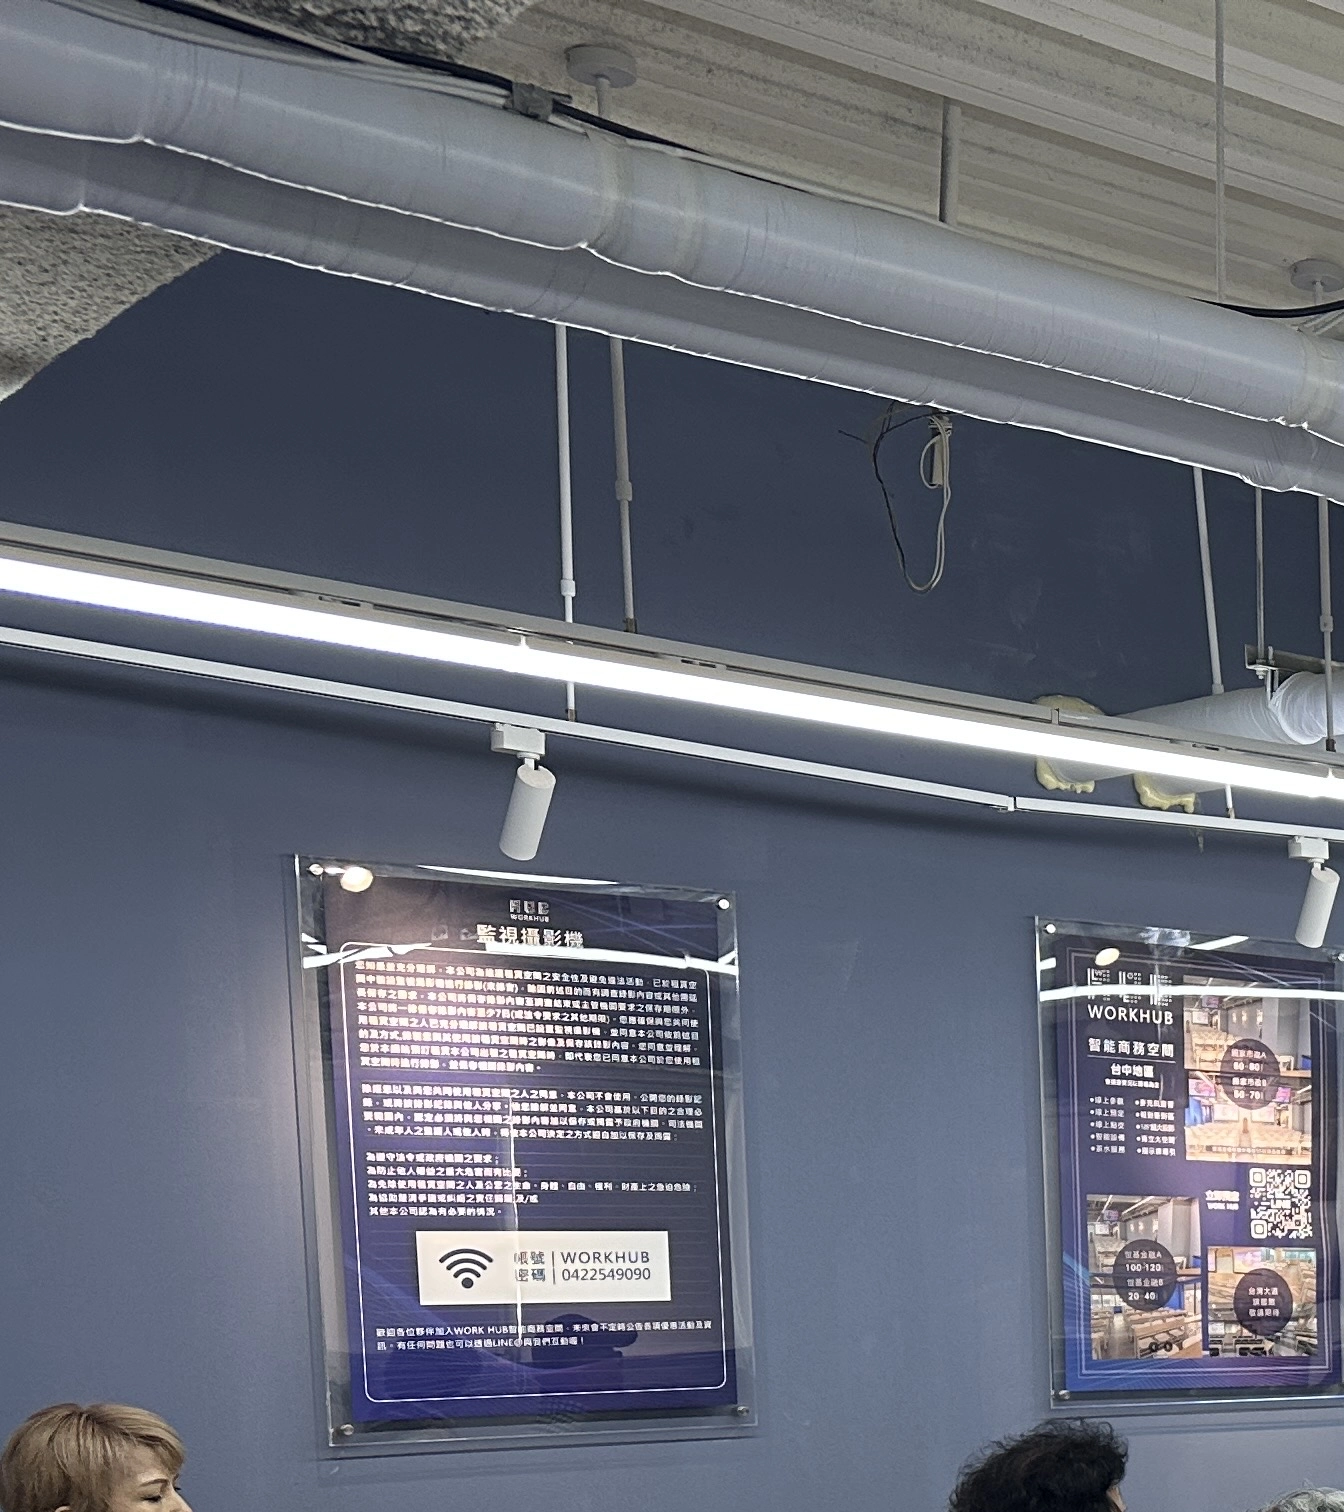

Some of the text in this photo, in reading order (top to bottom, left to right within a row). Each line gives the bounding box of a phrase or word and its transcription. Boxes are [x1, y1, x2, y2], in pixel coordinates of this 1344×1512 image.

[1087, 1003, 1174, 1025] WORKHUB
[1088, 1037, 1174, 1058] 智能商務空間
[559, 1251, 651, 1264] WORKHUB
[561, 1267, 651, 1281] 0422549090
